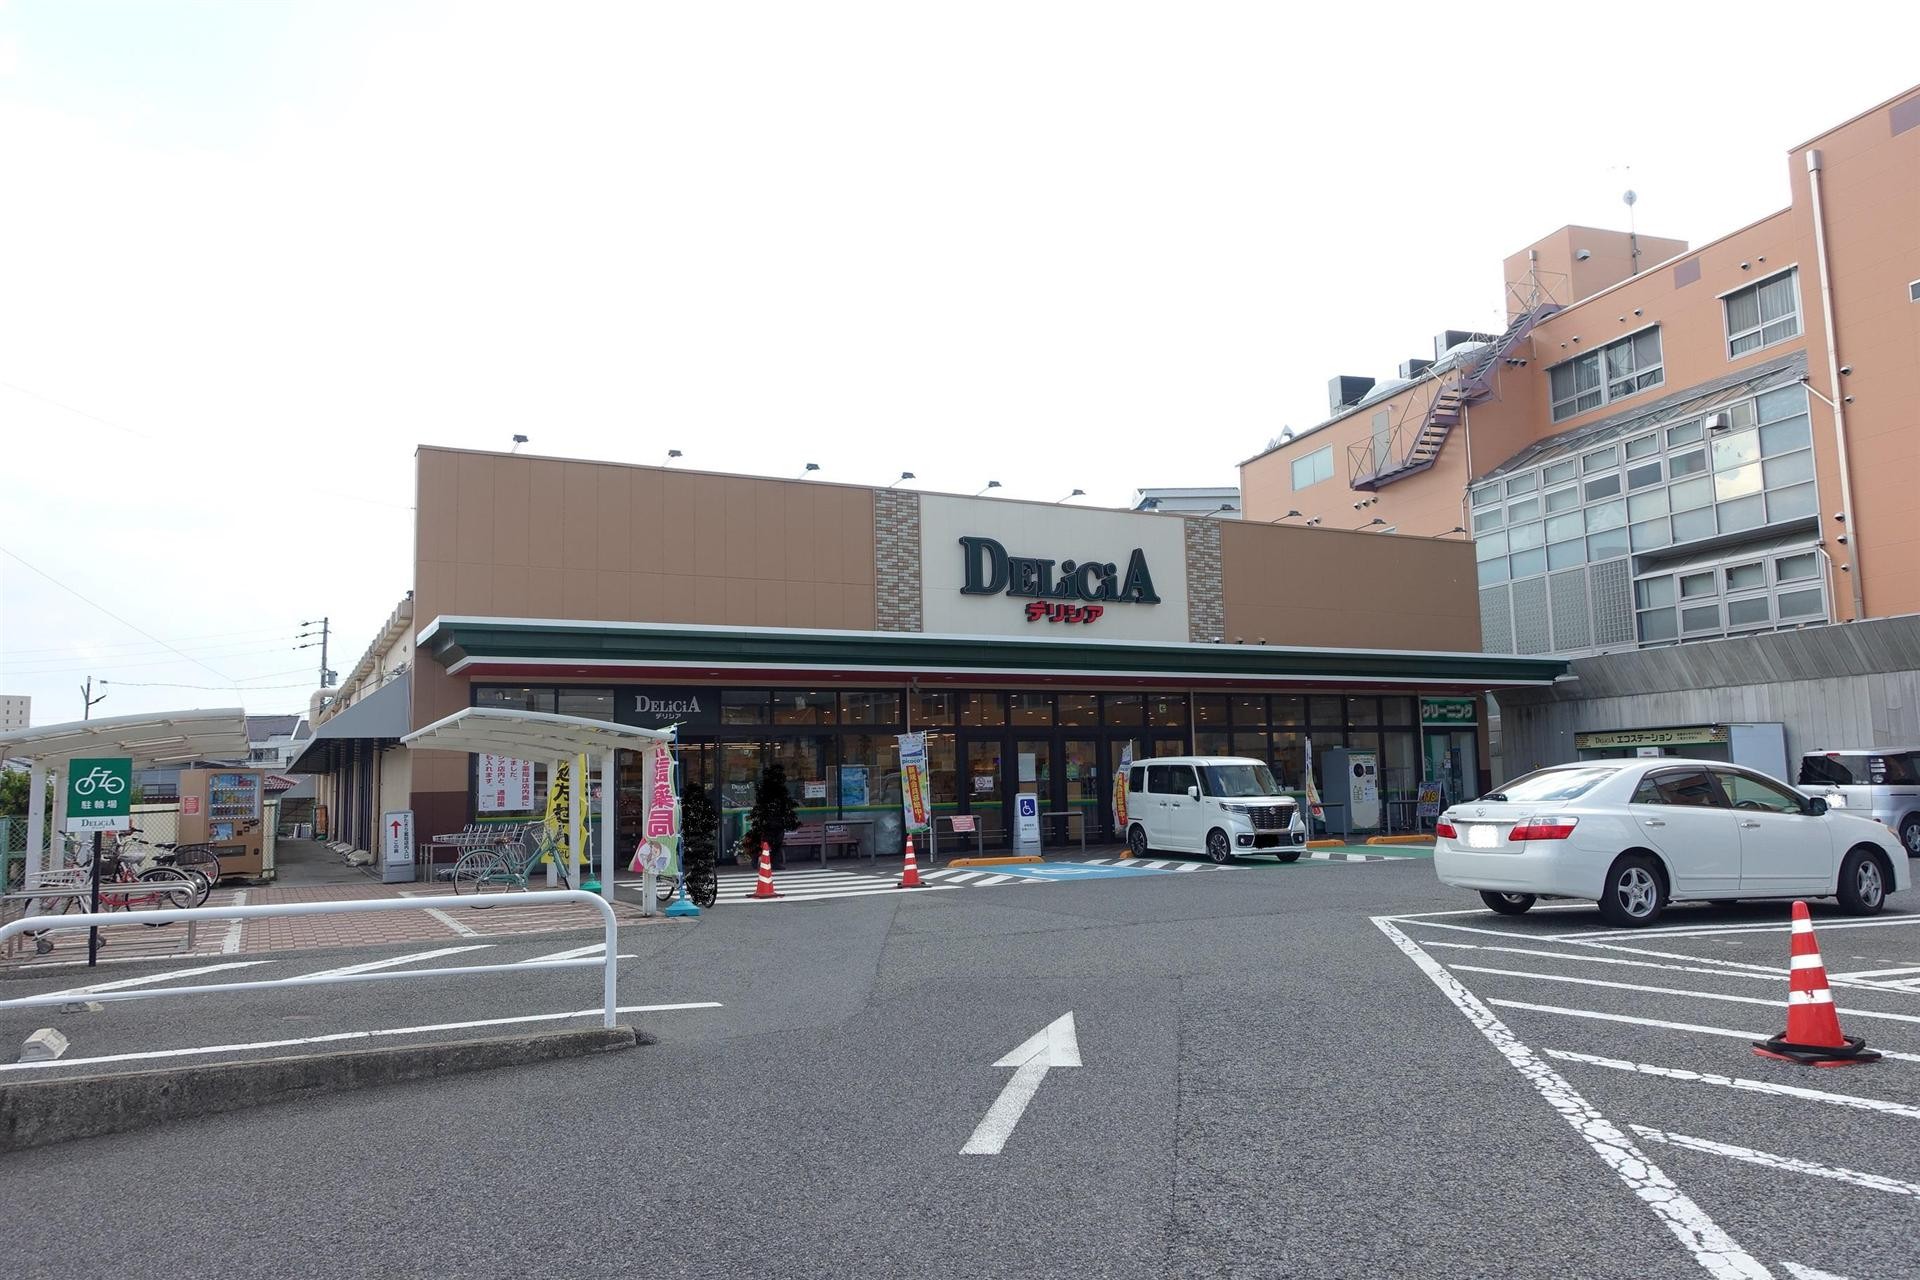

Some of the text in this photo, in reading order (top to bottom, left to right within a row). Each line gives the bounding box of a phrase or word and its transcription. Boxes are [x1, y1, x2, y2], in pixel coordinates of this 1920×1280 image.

[1025, 600, 1104, 623] デリシア
[1423, 704, 1473, 718] クリーニング
[1616, 733, 1673, 744] エコステーション
[81, 800, 117, 809] 駐輪場
